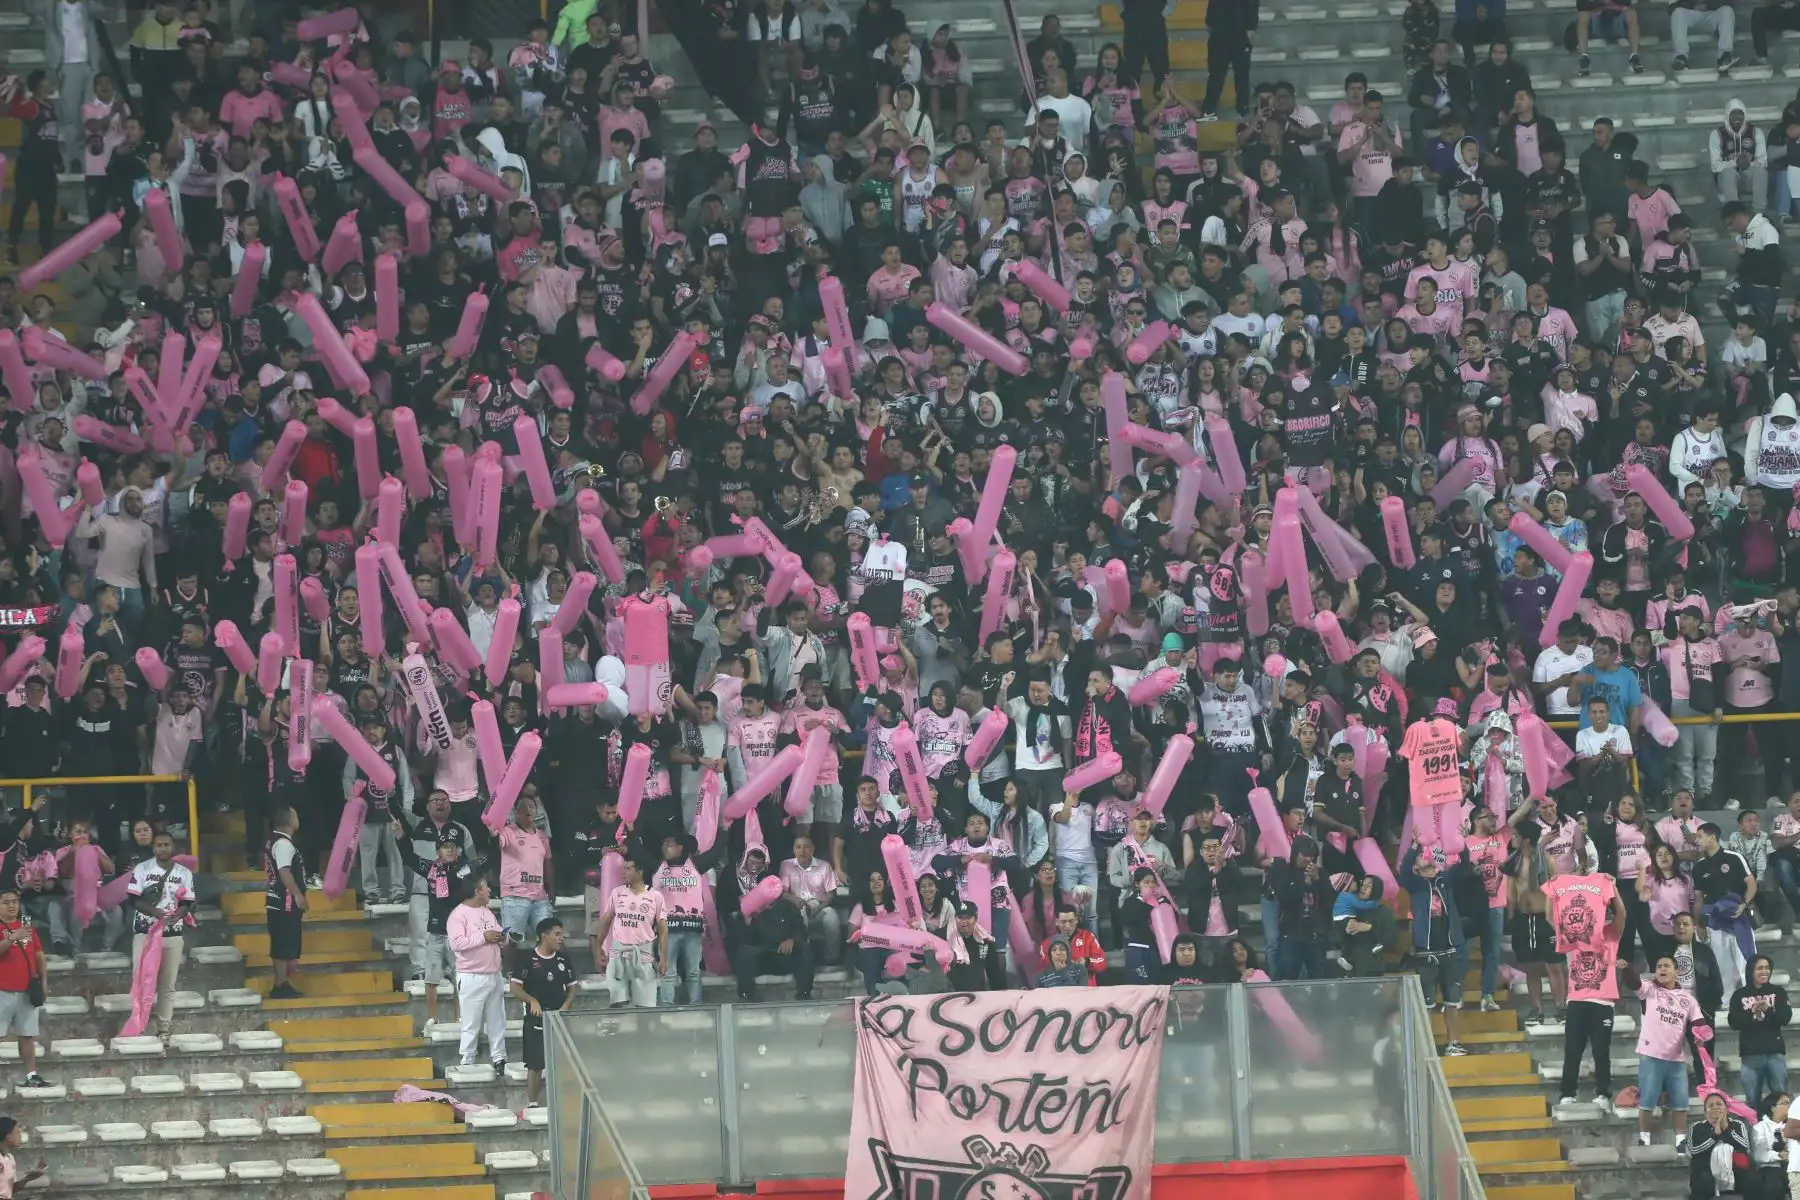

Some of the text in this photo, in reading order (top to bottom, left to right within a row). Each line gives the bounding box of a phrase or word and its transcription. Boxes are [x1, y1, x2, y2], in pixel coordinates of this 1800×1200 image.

[746, 742, 776, 751] apuesta
[751, 748, 770, 758] total
[1422, 752, 1458, 776] 1991
[616, 912, 646, 922] apuesta
[621, 919, 638, 929] total
